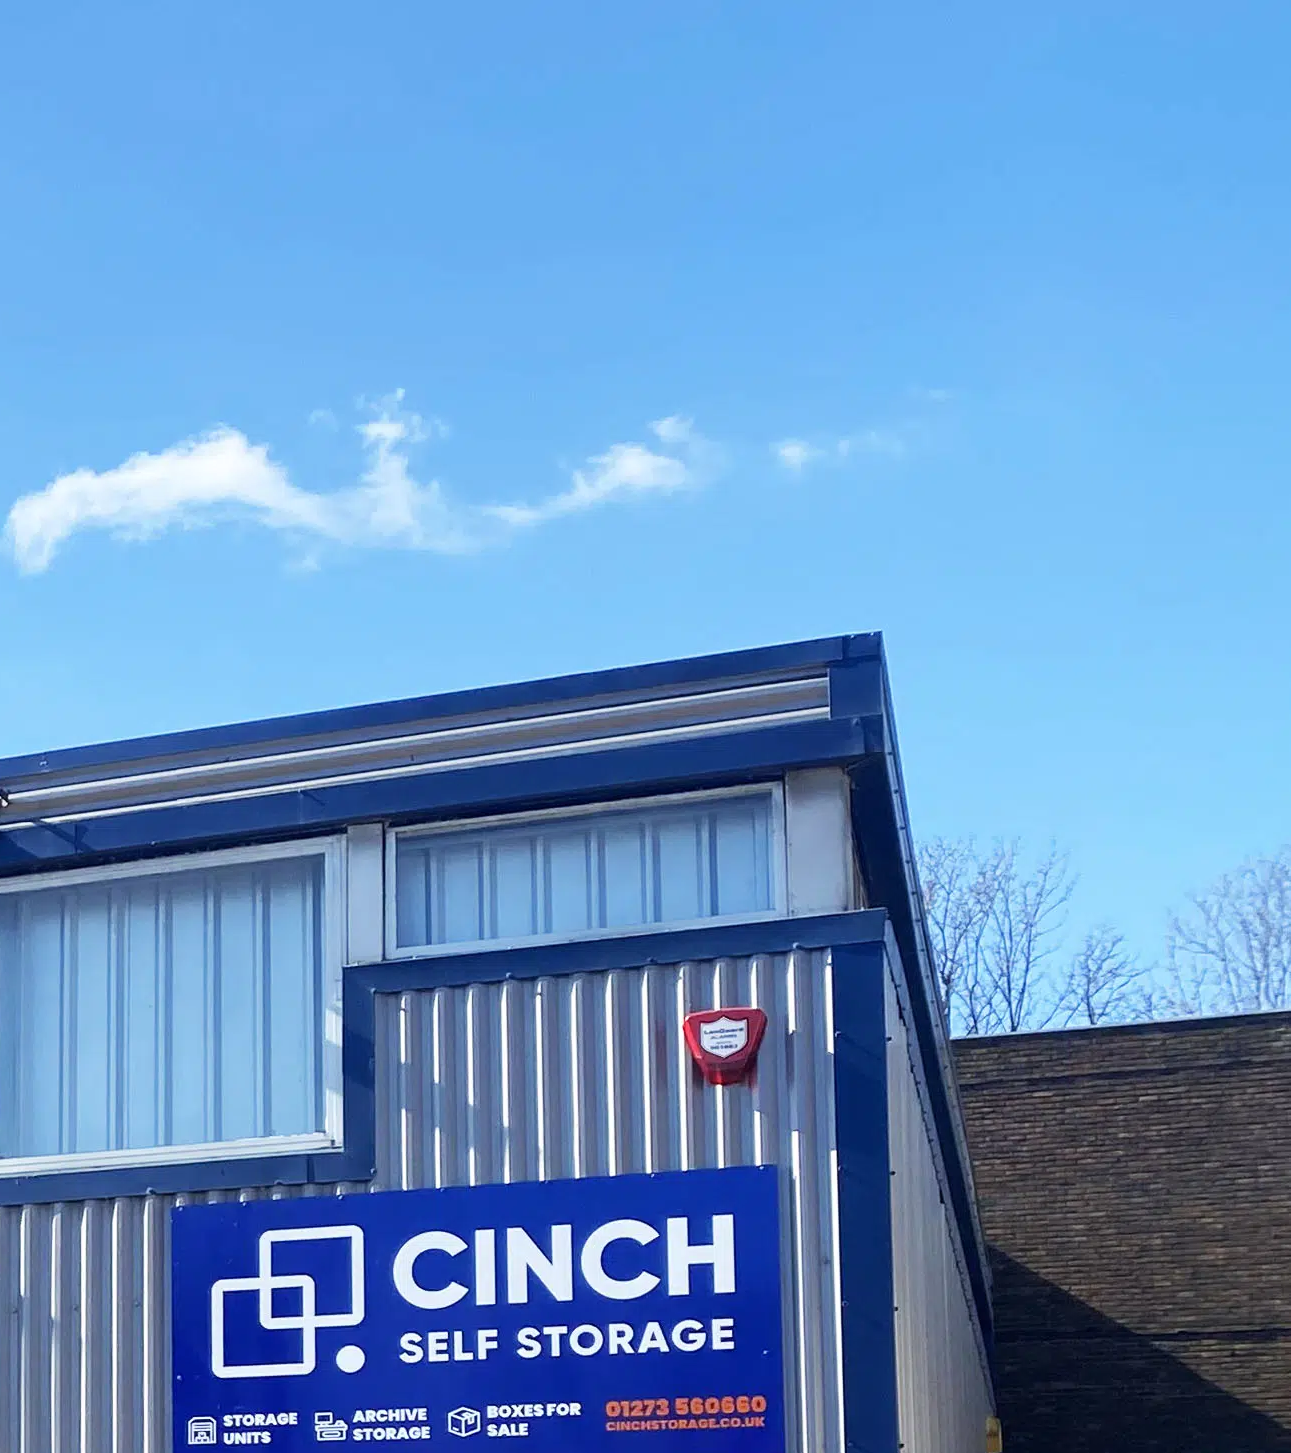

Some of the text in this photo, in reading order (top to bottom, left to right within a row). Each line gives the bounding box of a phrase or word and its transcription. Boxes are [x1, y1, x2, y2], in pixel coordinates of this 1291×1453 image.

[392, 1214, 736, 1310] CINCH
[399, 1318, 735, 1364] SELF STORAGE
[486, 1402, 582, 1419] BOXES FOR
[605, 1395, 767, 1418] 01273 560660
[223, 1412, 298, 1427] STORAGE
[352, 1407, 428, 1423] ARCHIVE
[486, 1422, 529, 1437] SALE
[605, 1416, 765, 1432] CINCHSTORAGE.CO.UK
[223, 1431, 272, 1445] UNITS
[352, 1426, 431, 1441] STORAGE
